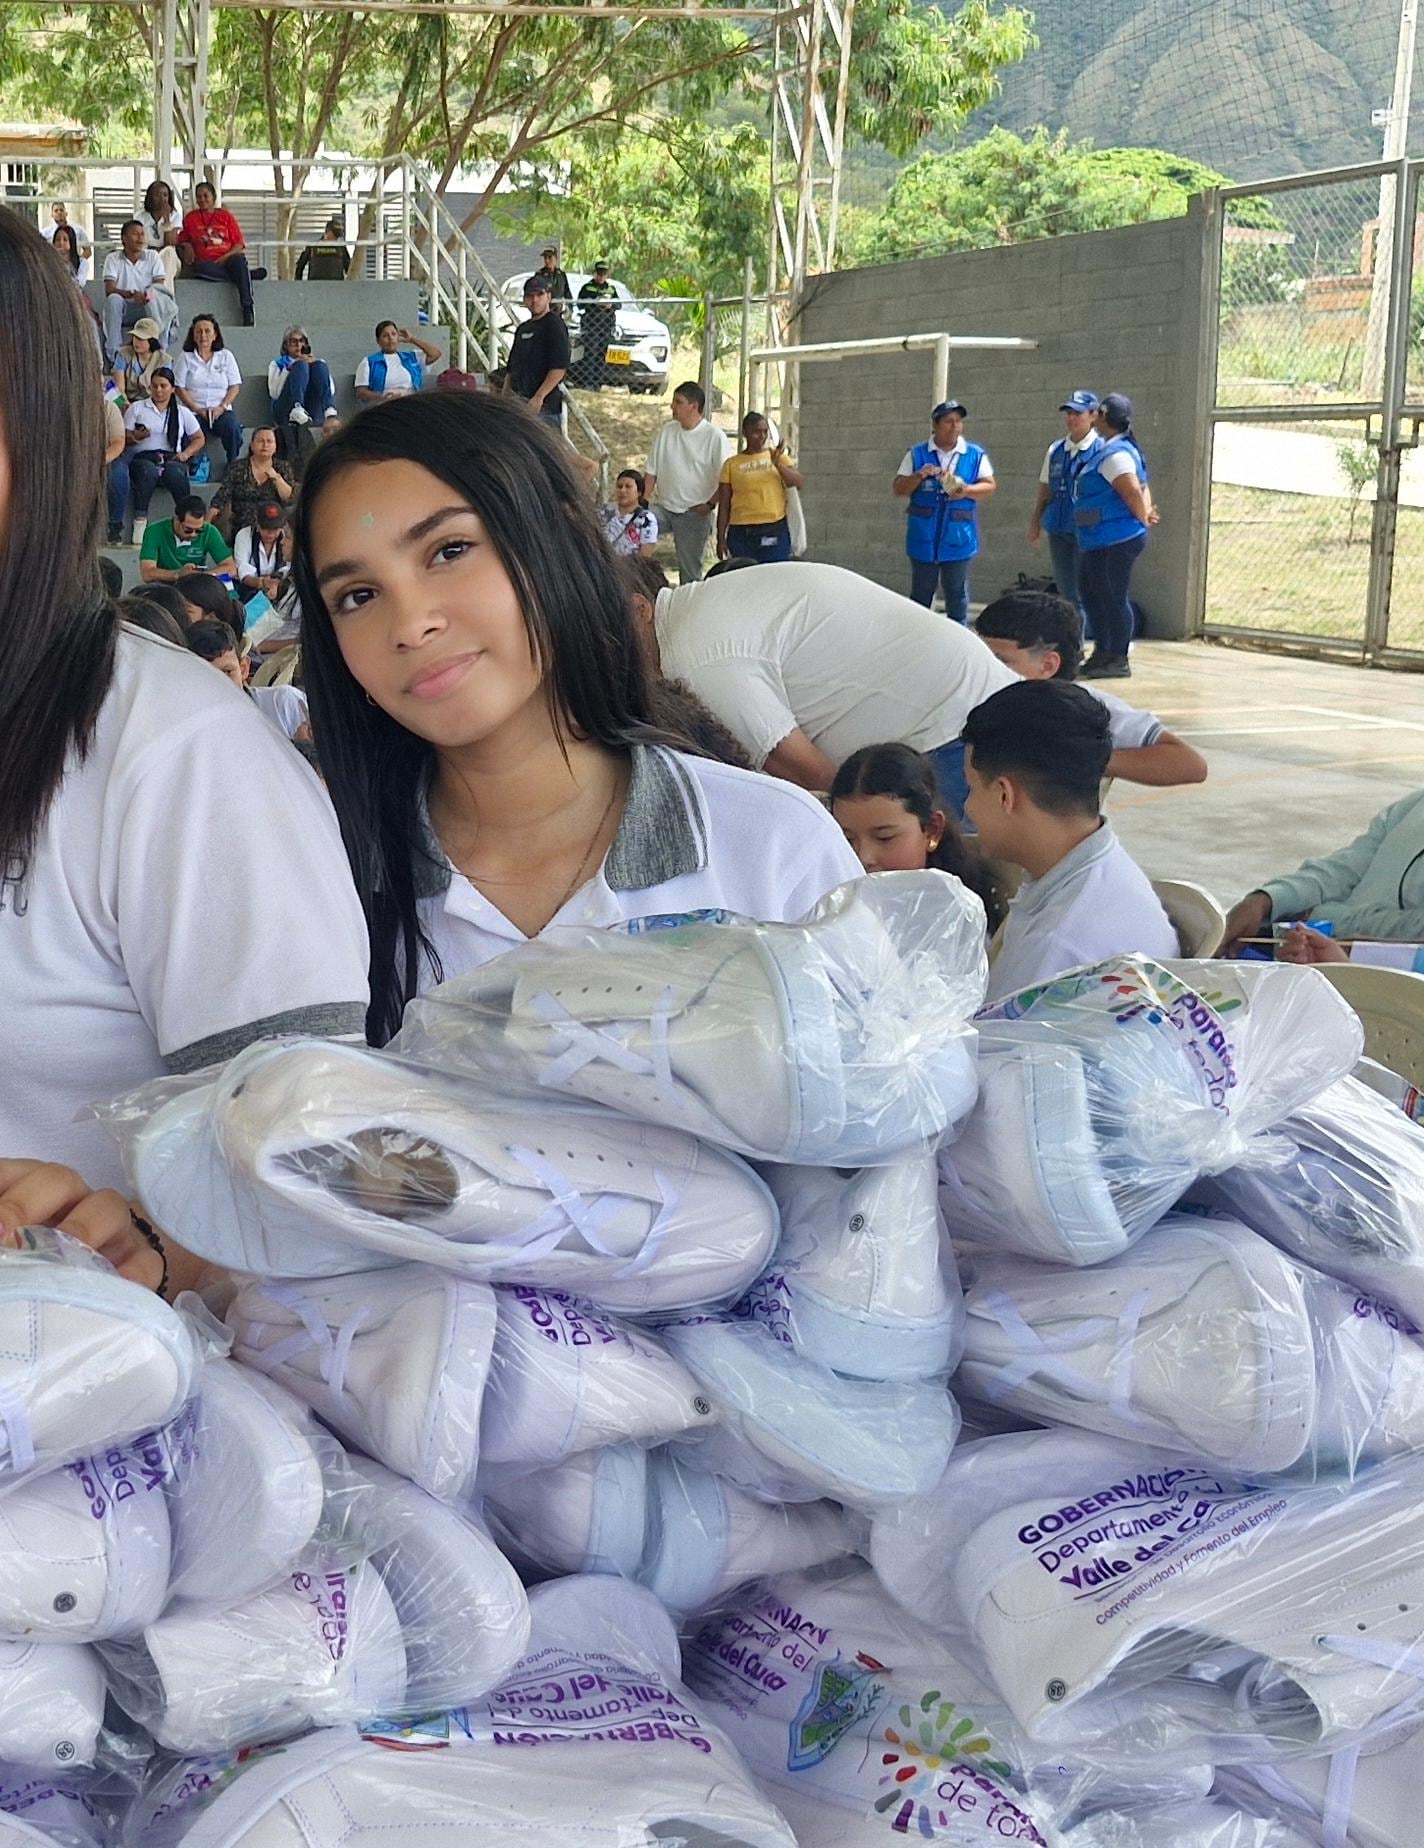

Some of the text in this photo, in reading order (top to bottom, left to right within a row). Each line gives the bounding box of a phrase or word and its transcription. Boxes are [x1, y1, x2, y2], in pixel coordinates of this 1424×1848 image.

[1017, 1466, 1208, 1545] GOBERNACIÓ
[1037, 1490, 1190, 1574] Departamento
[1060, 1556, 1132, 1591] Valle
[1134, 1534, 1177, 1562] del
[1095, 1565, 1178, 1626] Competitividad
[1176, 1560, 1185, 1575] y
[1184, 1535, 1232, 1566] Fomento
[1231, 1520, 1251, 1539] del
[1248, 1498, 1288, 1531] Empleo
[719, 1639, 748, 1667] del
[782, 1643, 814, 1673] del
[529, 1699, 701, 1730] Deprtamento
[936, 1780, 977, 1813] de
